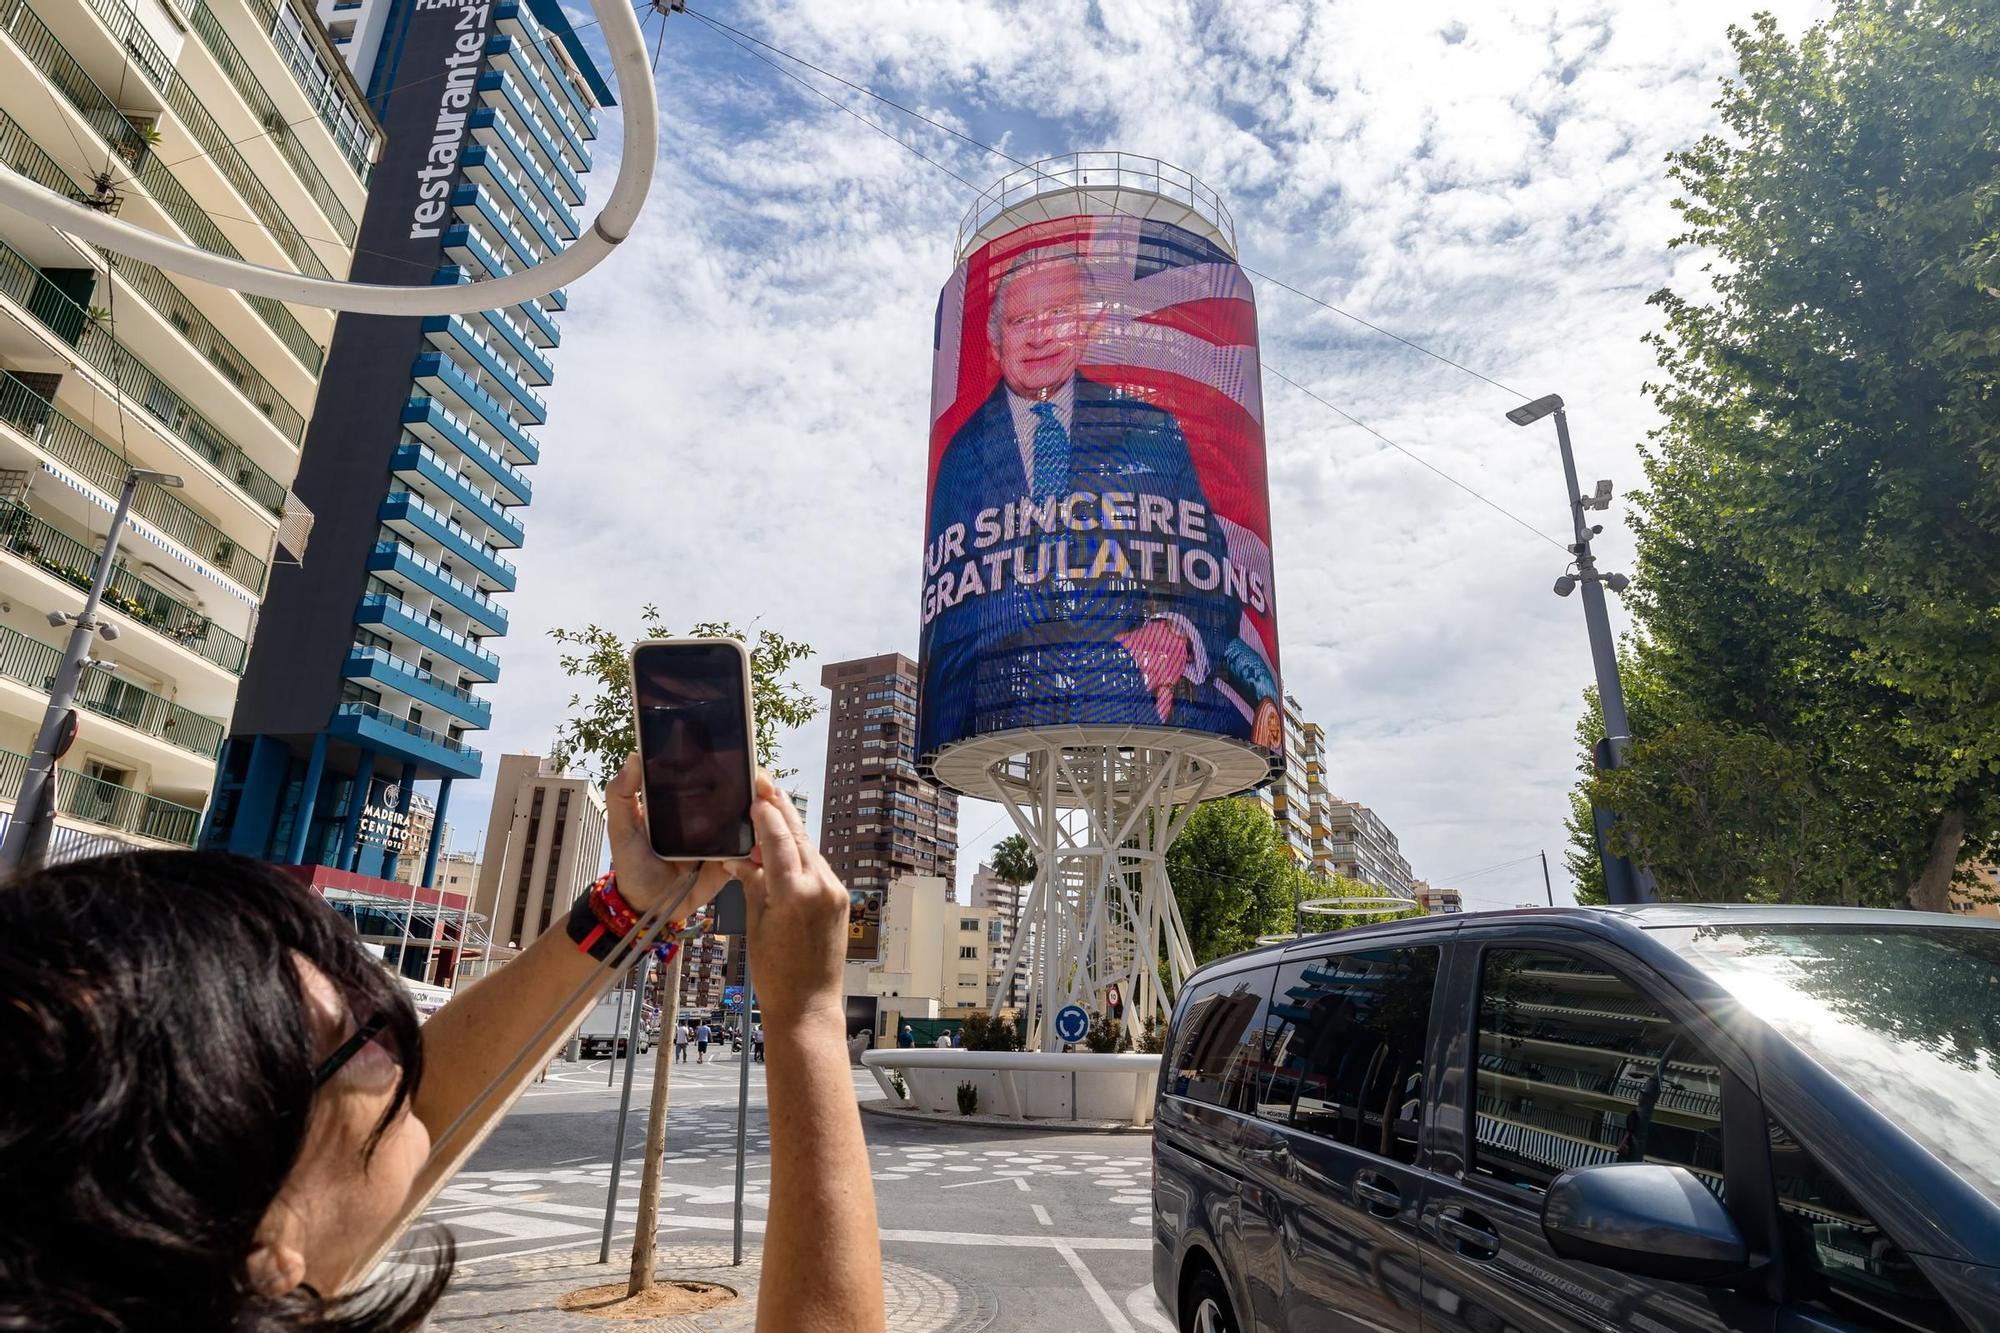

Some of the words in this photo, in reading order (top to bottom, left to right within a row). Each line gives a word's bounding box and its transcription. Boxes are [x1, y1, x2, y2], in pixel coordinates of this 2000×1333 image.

[454, 4, 490, 31] 21
[409, 32, 486, 239] restaurante
[974, 491, 1208, 549] SINCERE
[921, 538, 1265, 628] GRATULATIONS
[361, 818, 409, 841] CENTRO
[363, 804, 411, 828] MADEIRA
[382, 838, 406, 850] HOTEL
